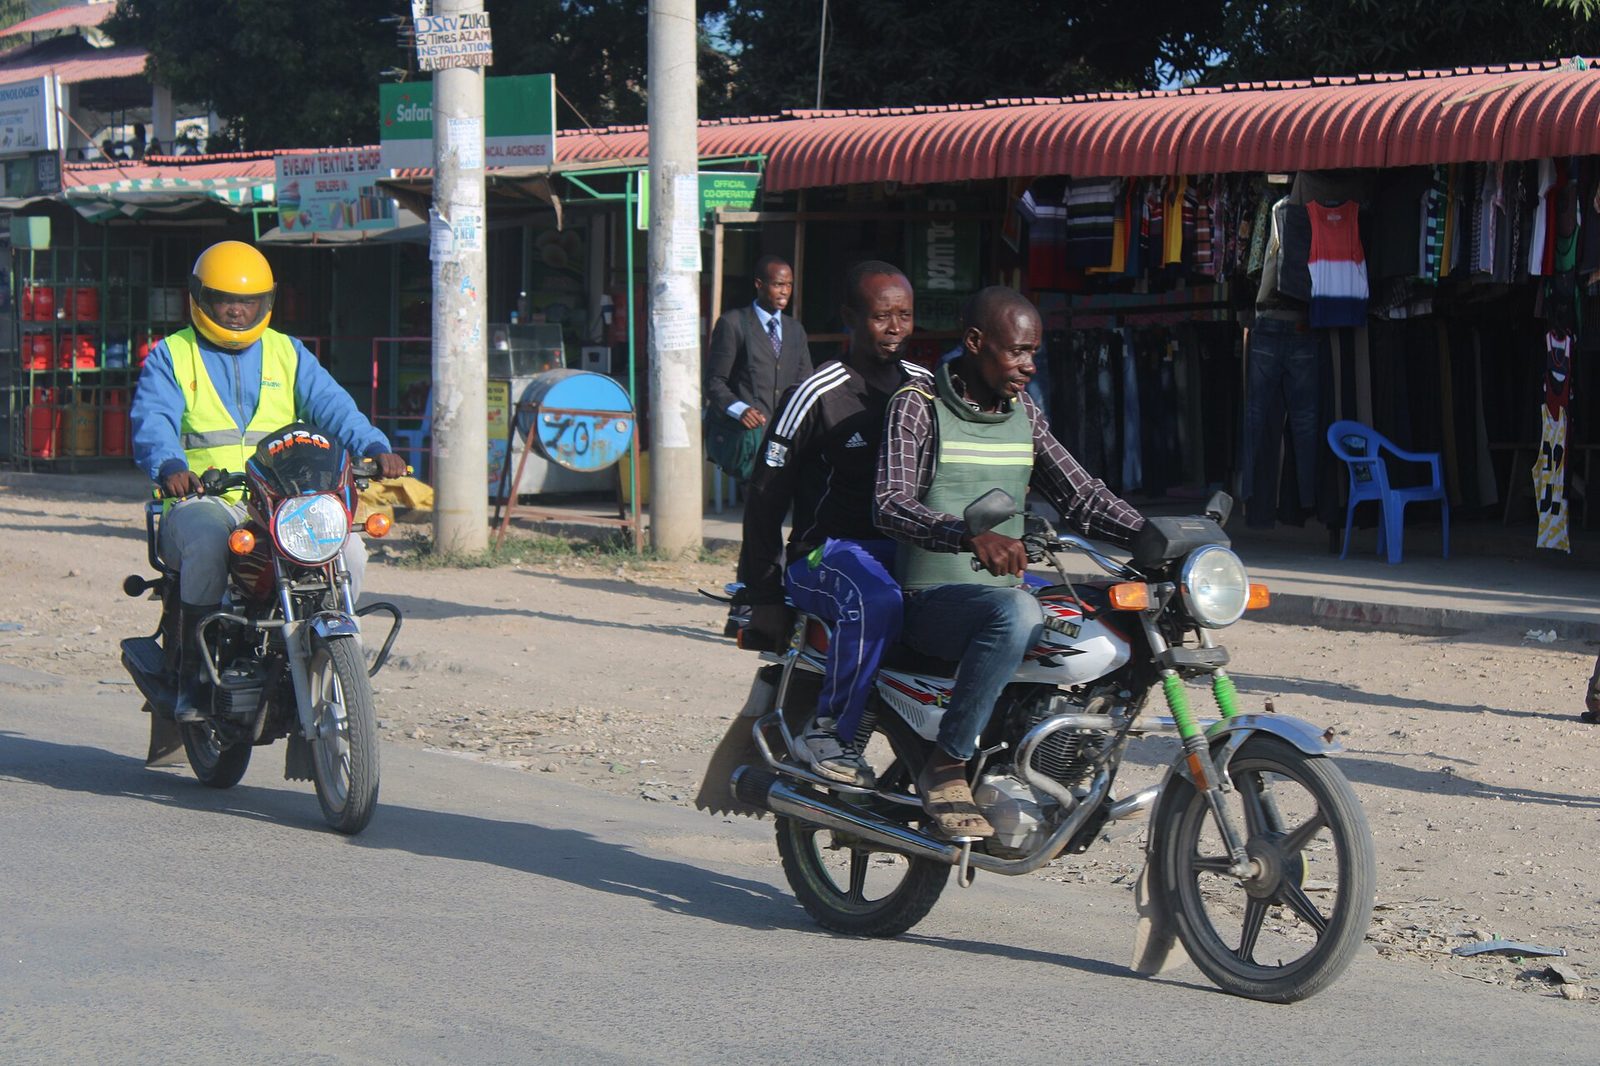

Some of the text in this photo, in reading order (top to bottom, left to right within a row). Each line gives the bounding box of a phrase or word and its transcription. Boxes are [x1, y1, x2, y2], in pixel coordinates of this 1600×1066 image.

[459, 30, 490, 41] AZAM
[417, 42, 492, 56] INSTALLATION
[506, 144, 546, 157] AGENCIES
[283, 152, 381, 176] EVEJOY TEXTILE SHOP
[713, 180, 746, 188] OFFICIAL
